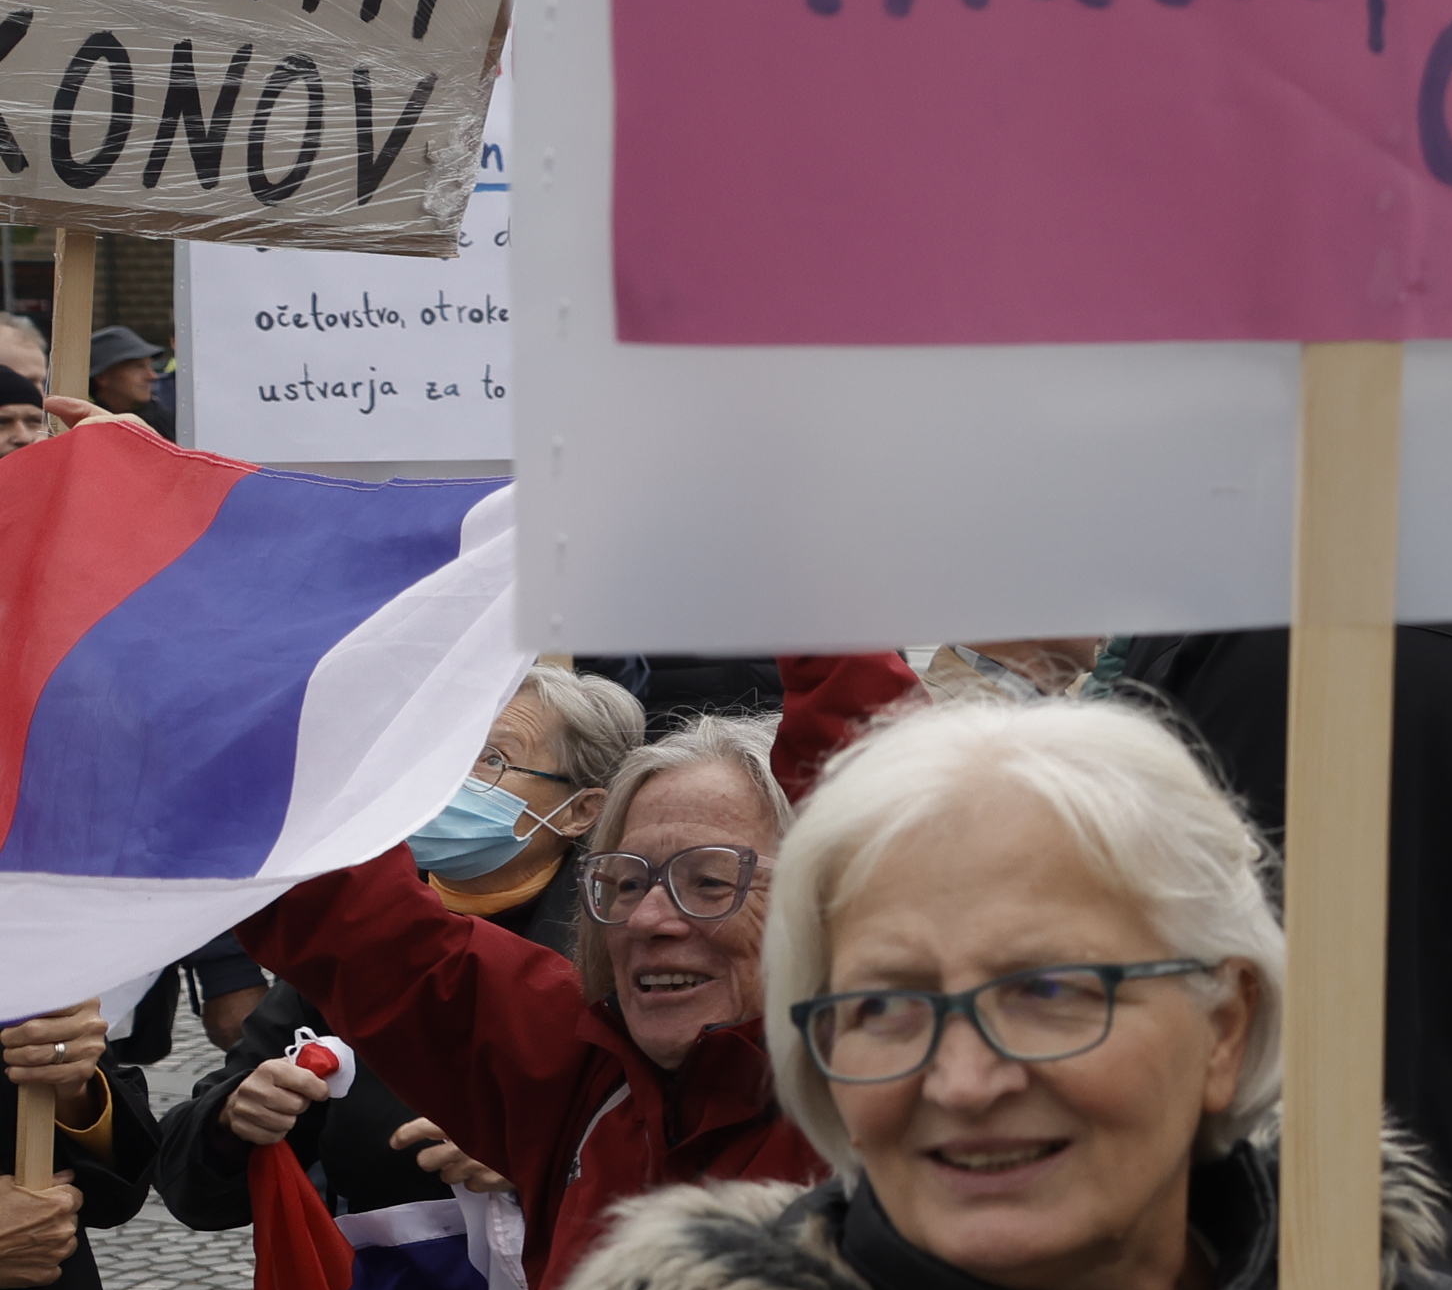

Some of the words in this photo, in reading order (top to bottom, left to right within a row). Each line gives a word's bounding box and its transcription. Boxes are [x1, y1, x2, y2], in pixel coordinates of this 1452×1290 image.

[255, 292, 405, 331] očetovstvo,
[419, 290, 510, 326] otroke
[259, 364, 399, 415] ustvarja
[425, 382, 460, 400] za
